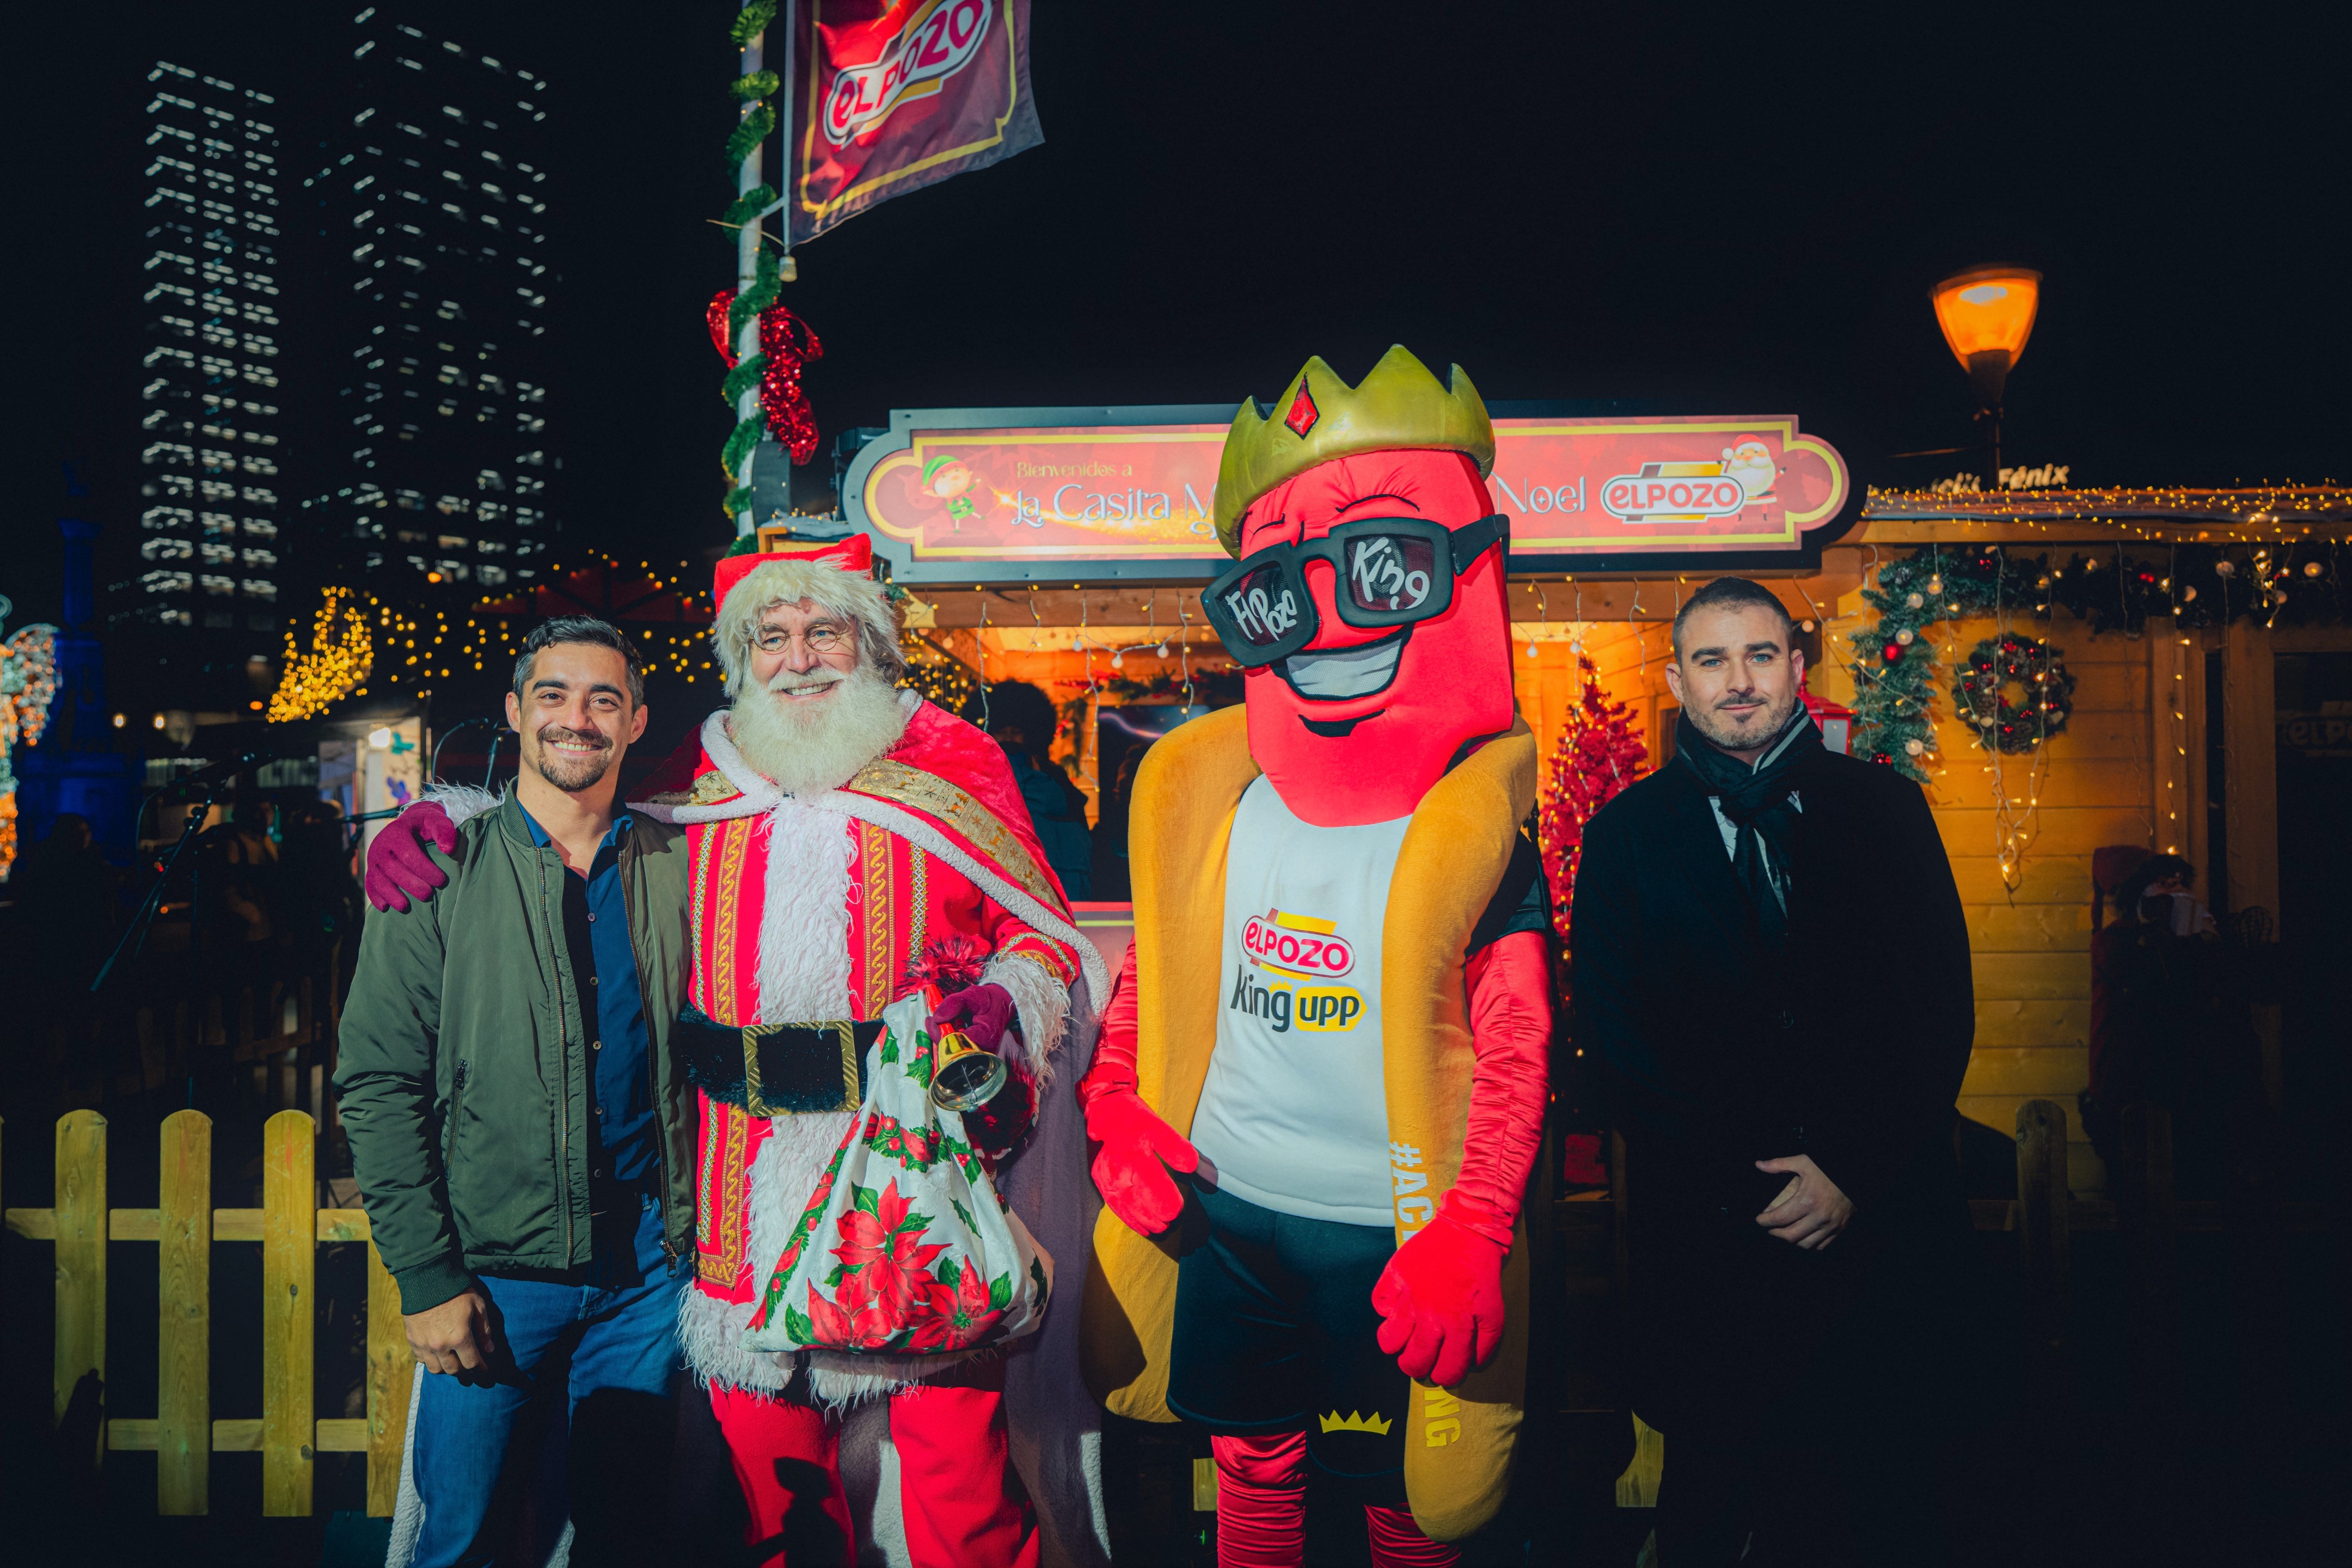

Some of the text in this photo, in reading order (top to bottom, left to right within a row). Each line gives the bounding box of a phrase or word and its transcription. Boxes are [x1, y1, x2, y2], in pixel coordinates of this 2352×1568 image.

[1016, 461, 1132, 478] Bienvenidos a
[1010, 489, 1045, 529] La
[1052, 483, 1171, 521] Casita
[1491, 471, 1586, 513] Noel
[2288, 720, 2352, 745] eLP
[1299, 996, 1360, 1026] upp
[1389, 1141, 1434, 1241] #AC
